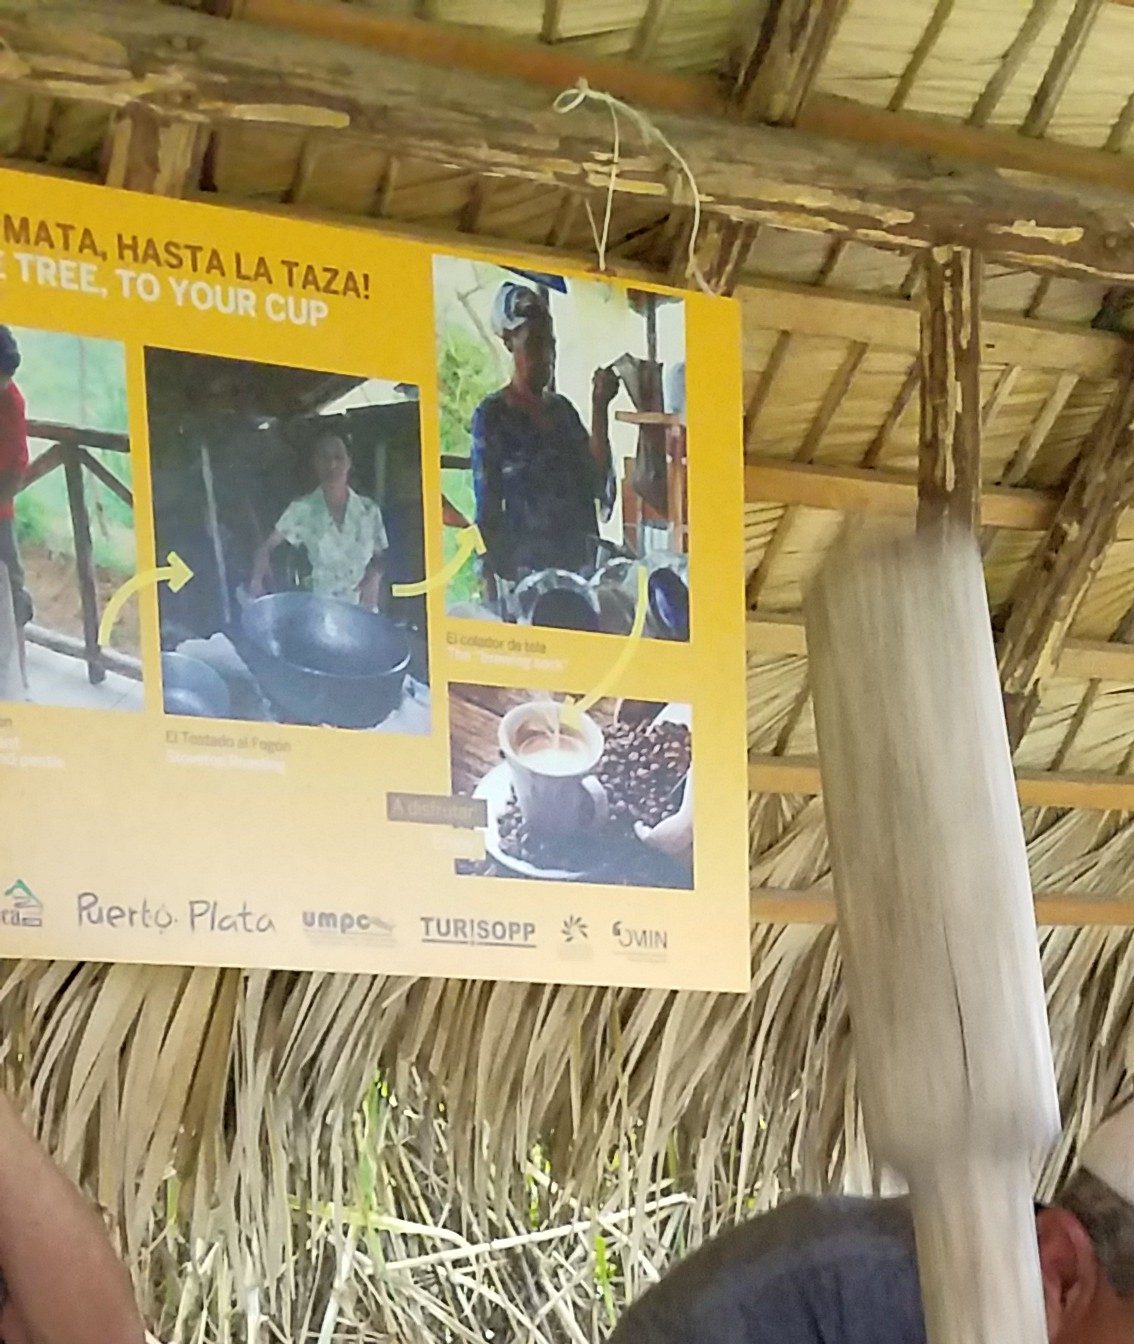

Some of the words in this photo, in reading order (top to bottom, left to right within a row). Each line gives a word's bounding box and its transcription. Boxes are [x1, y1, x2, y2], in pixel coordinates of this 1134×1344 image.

[3, 213, 108, 262] MATA,
[117, 232, 226, 278] HASTA
[235, 251, 273, 285] LA
[281, 259, 370, 300] TAZA!
[14, 251, 108, 299] TREE,
[115, 267, 161, 302] TO
[168, 275, 257, 318] YOUR
[265, 292, 330, 328] CUP
[77, 892, 174, 933] Puerto
[188, 899, 276, 934] Plata
